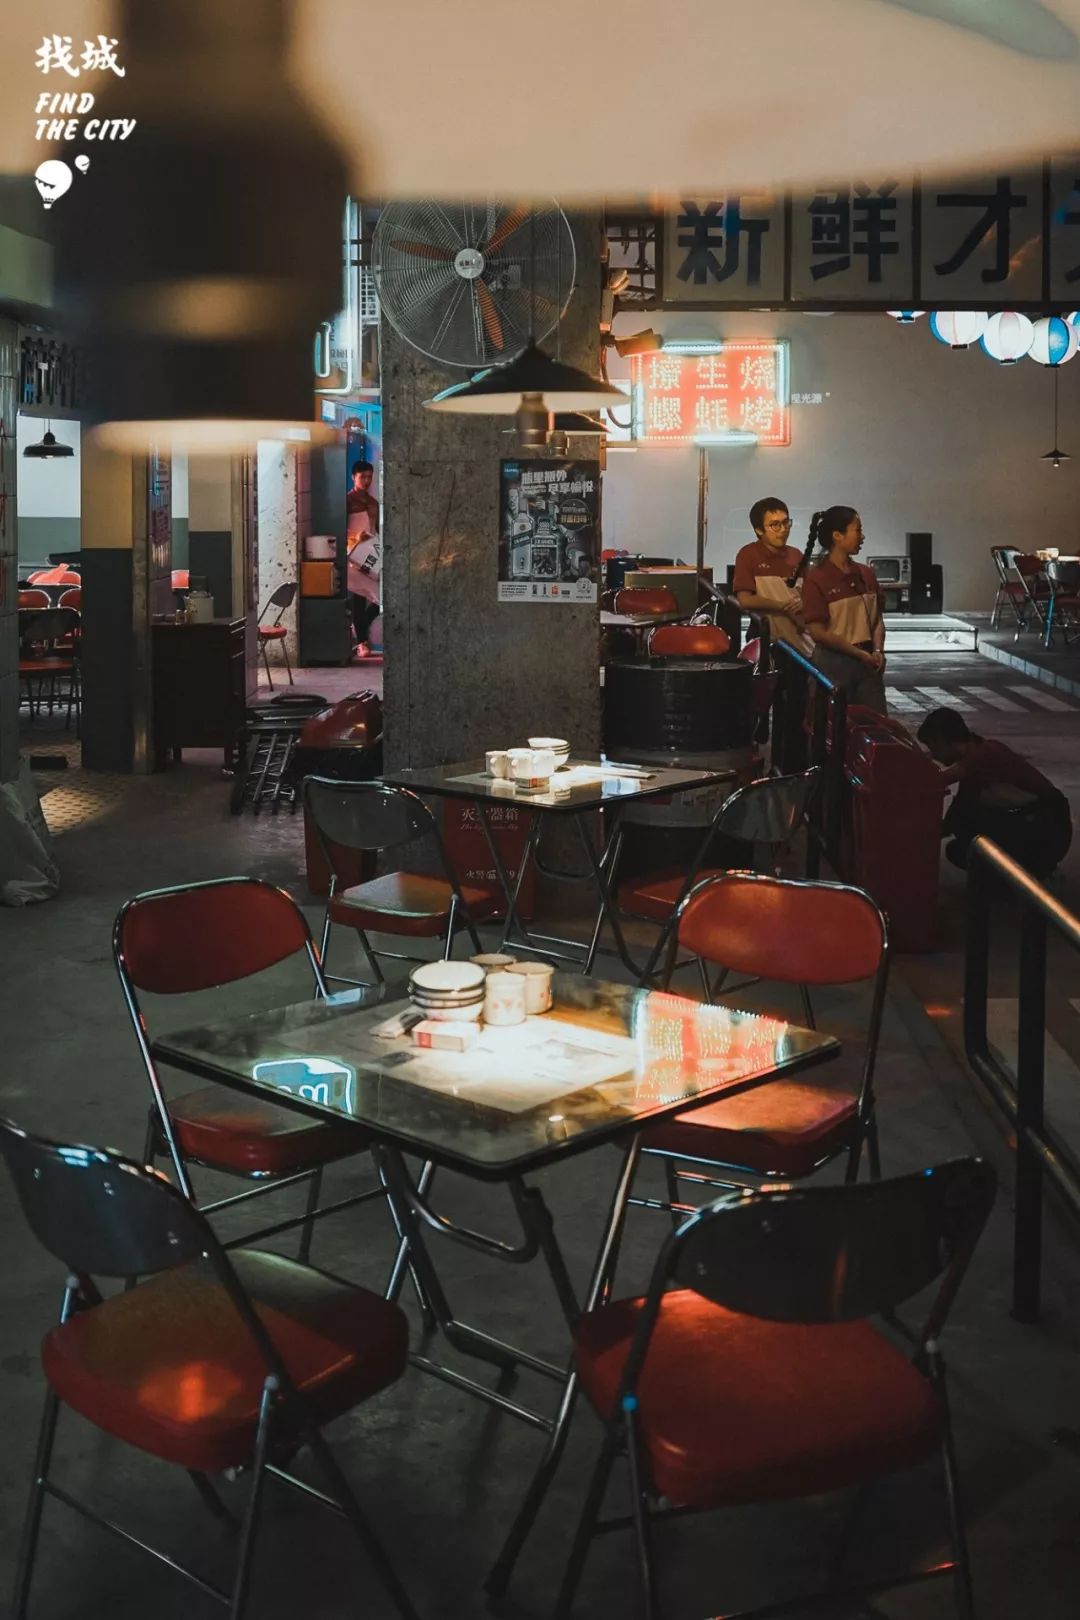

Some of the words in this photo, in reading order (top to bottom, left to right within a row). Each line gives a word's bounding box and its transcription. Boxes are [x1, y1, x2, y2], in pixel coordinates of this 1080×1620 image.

[676, 178, 1080, 285] 新鲜才
[459, 807, 520, 821] 灭器箱
